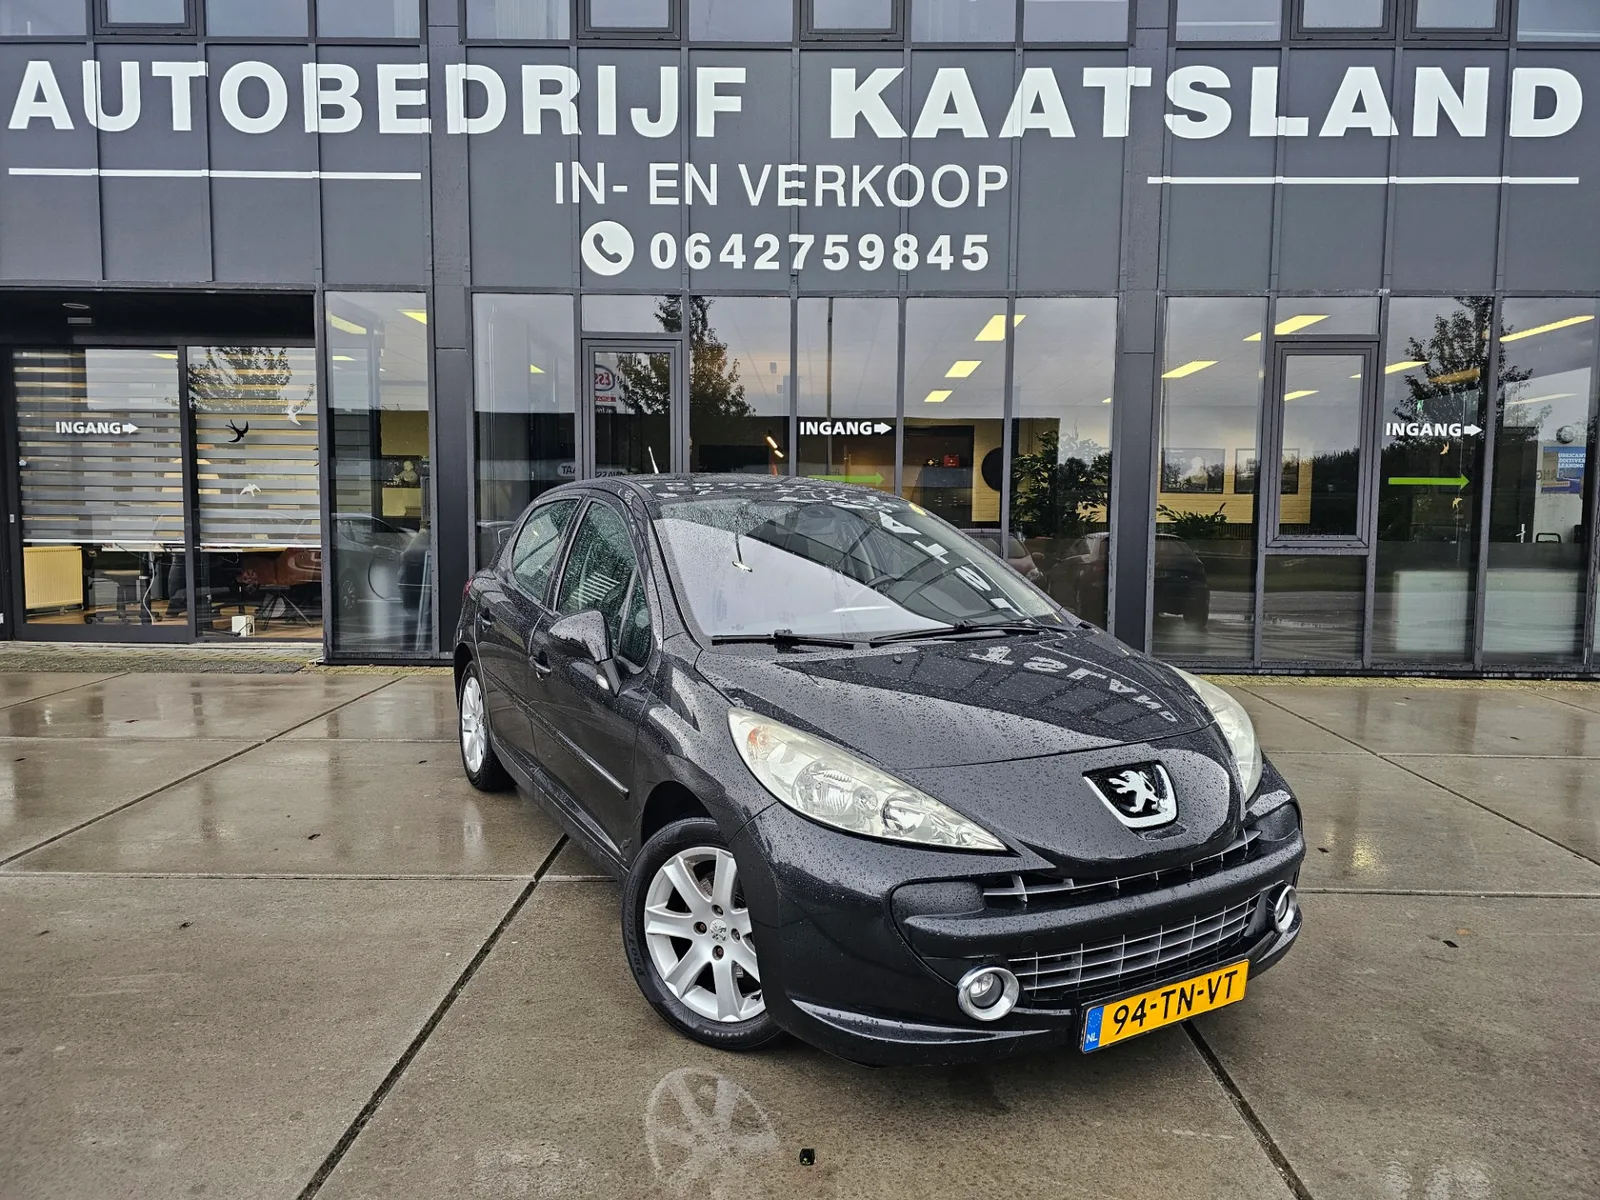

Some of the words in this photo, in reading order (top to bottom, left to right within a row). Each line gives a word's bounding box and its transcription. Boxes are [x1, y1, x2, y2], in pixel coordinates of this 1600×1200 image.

[8, 60, 747, 138] AUTOBEDRIJF
[830, 65, 1583, 139] KAATSLAND
[555, 161, 628, 204] IN-
[649, 162, 718, 206] EN
[738, 163, 1008, 208] VERKOOP
[650, 232, 989, 271] 0642759845
[55, 421, 121, 434] INGANG
[800, 421, 873, 436] INGANG
[1385, 422, 1462, 437] INGANG
[1086, 1032, 1098, 1044] NL
[1113, 970, 1238, 1036] 94-TN-VT
